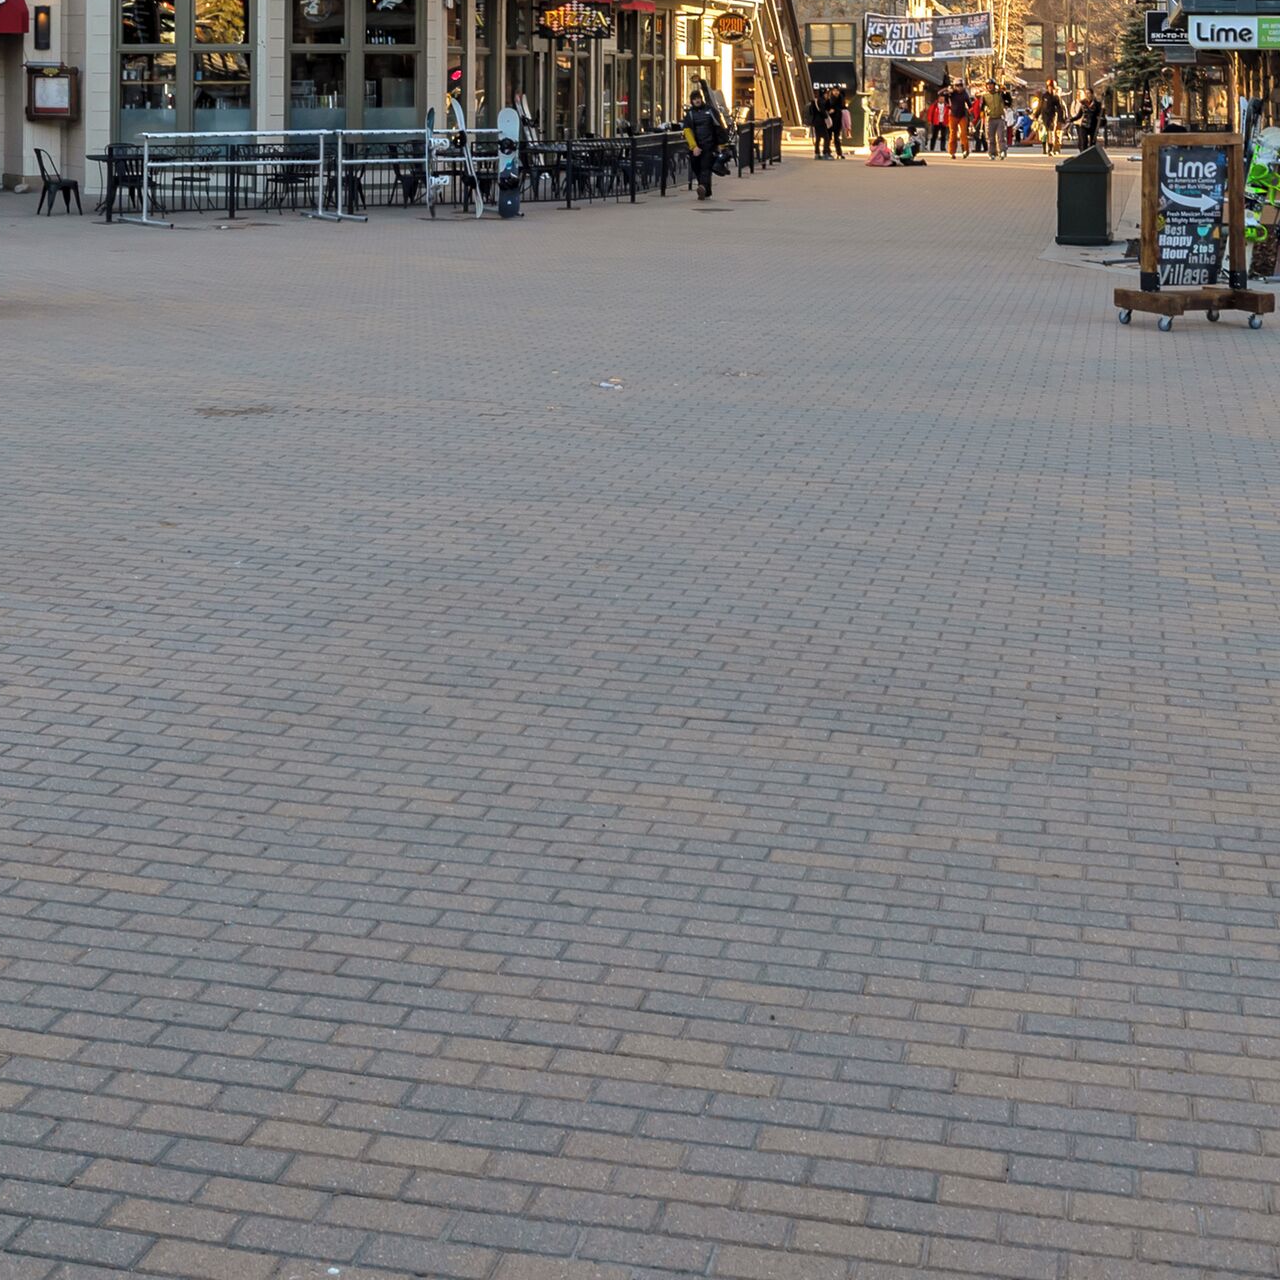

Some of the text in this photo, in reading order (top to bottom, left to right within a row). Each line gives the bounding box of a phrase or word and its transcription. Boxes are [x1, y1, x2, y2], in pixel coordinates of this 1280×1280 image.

[545, 10, 608, 27] PIZZA
[868, 21, 933, 39] KEYSTONE
[1196, 23, 1253, 42] Lime
[1165, 156, 1217, 178] Lime
[1165, 225, 1186, 235] Best
[1159, 234, 1192, 247] Happy
[1162, 248, 1189, 259] Hour
[1193, 244, 1214, 253] 2 to 5
[1199, 253, 1216, 265] the
[1157, 264, 1209, 285] Village
